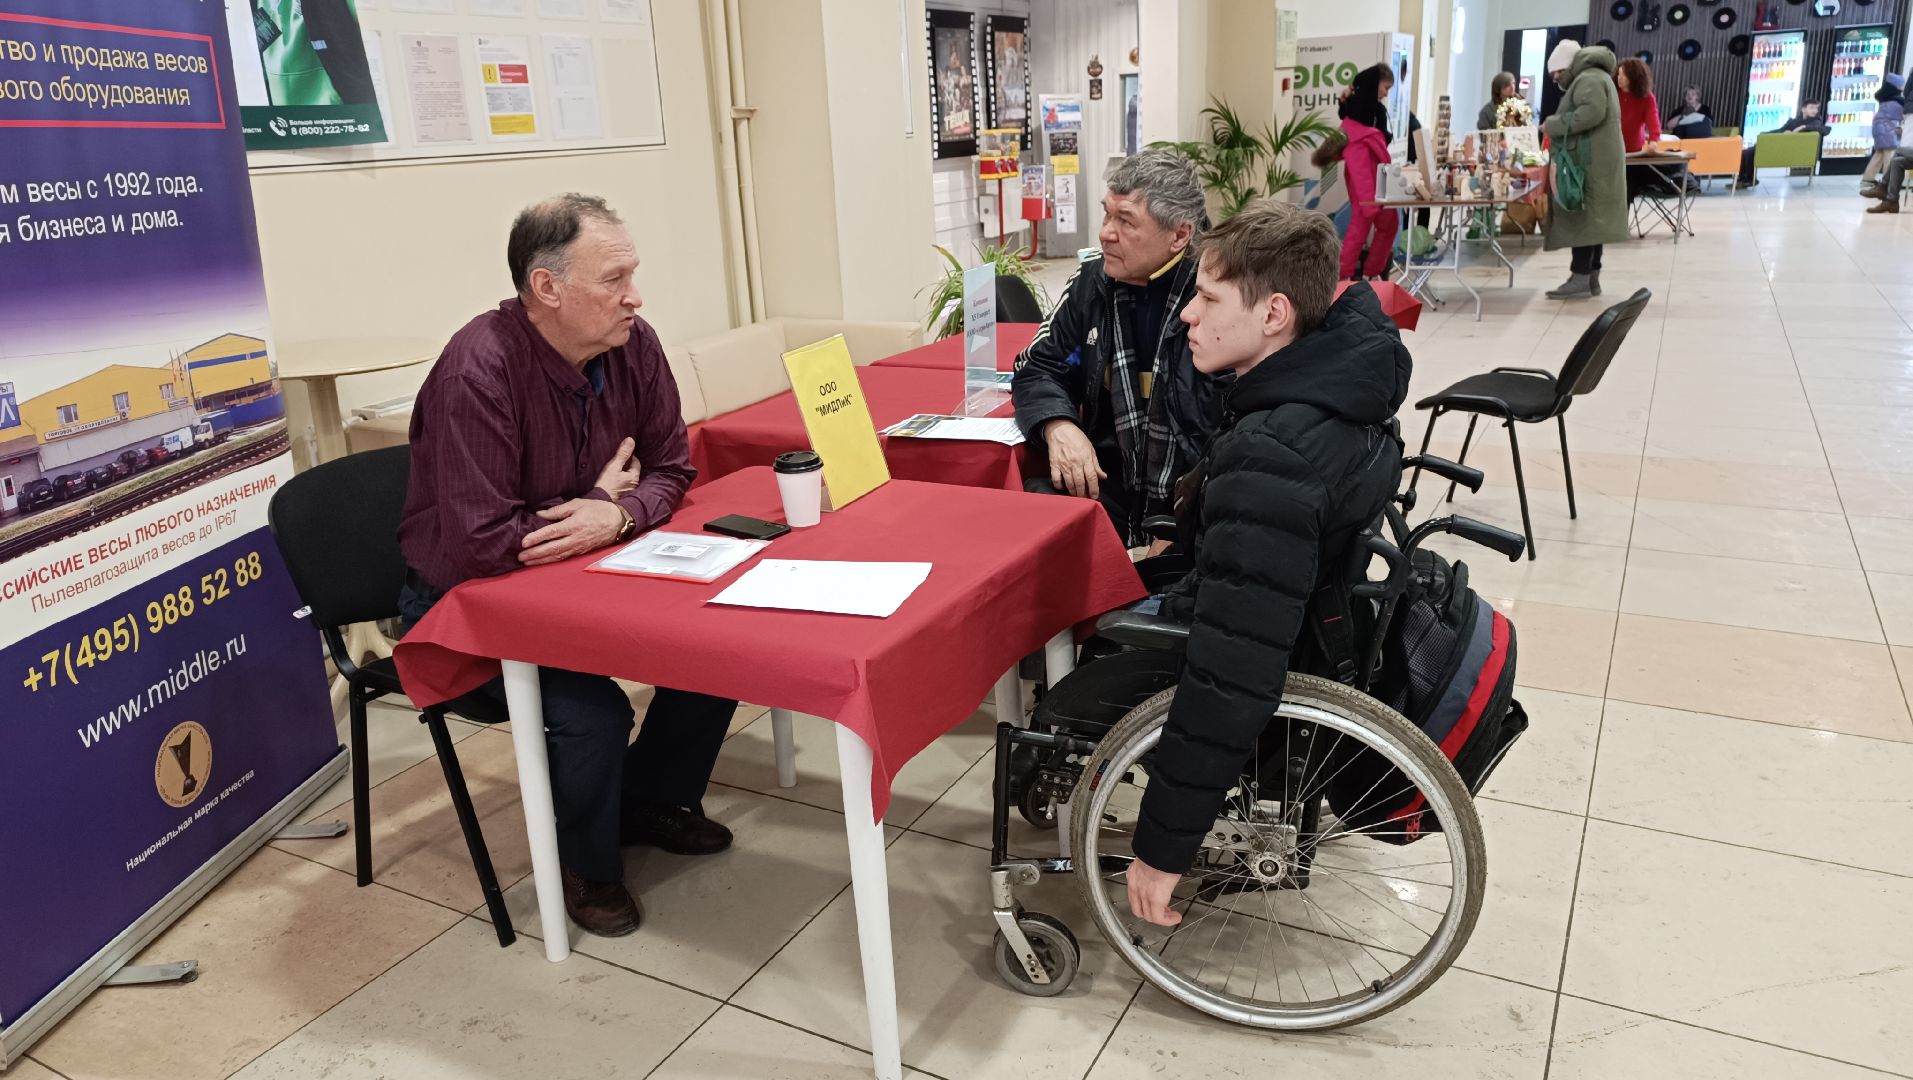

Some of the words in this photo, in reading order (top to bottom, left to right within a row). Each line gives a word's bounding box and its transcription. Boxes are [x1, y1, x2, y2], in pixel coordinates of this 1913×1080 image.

[43, 43, 56, 63] и
[61, 43, 149, 71] продажа
[154, 51, 208, 74] весов
[50, 76, 191, 109] оборудования
[291, 126, 298, 136] 8
[299, 126, 323, 137] (800)
[27, 180, 82, 203] весы
[87, 179, 98, 199] с
[104, 171, 151, 198] 1992
[156, 174, 203, 196] года.
[17, 213, 106, 242] бизнеса
[112, 213, 124, 232] и
[131, 209, 183, 235] дома.
[819, 381, 837, 396] ООО
[0, 553, 84, 602] СИЙСКИЕ
[88, 532, 132, 566] ВЕСЫ
[135, 508, 194, 545] ЛЮБОГО
[197, 474, 277, 518] НАЗНАЧЕНИЯ
[31, 547, 159, 613] Пылевлагозащита
[162, 531, 196, 556] весов
[199, 524, 212, 541] до
[214, 509, 238, 532] IP67
[23, 612, 140, 693] +7(495)
[146, 585, 195, 634] 988
[201, 568, 230, 606] 52
[234, 551, 263, 588] 88
[77, 633, 247, 748] www.middle.ru
[126, 816, 193, 871] Национальная
[194, 799, 219, 821] марка
[220, 769, 255, 800] качества
